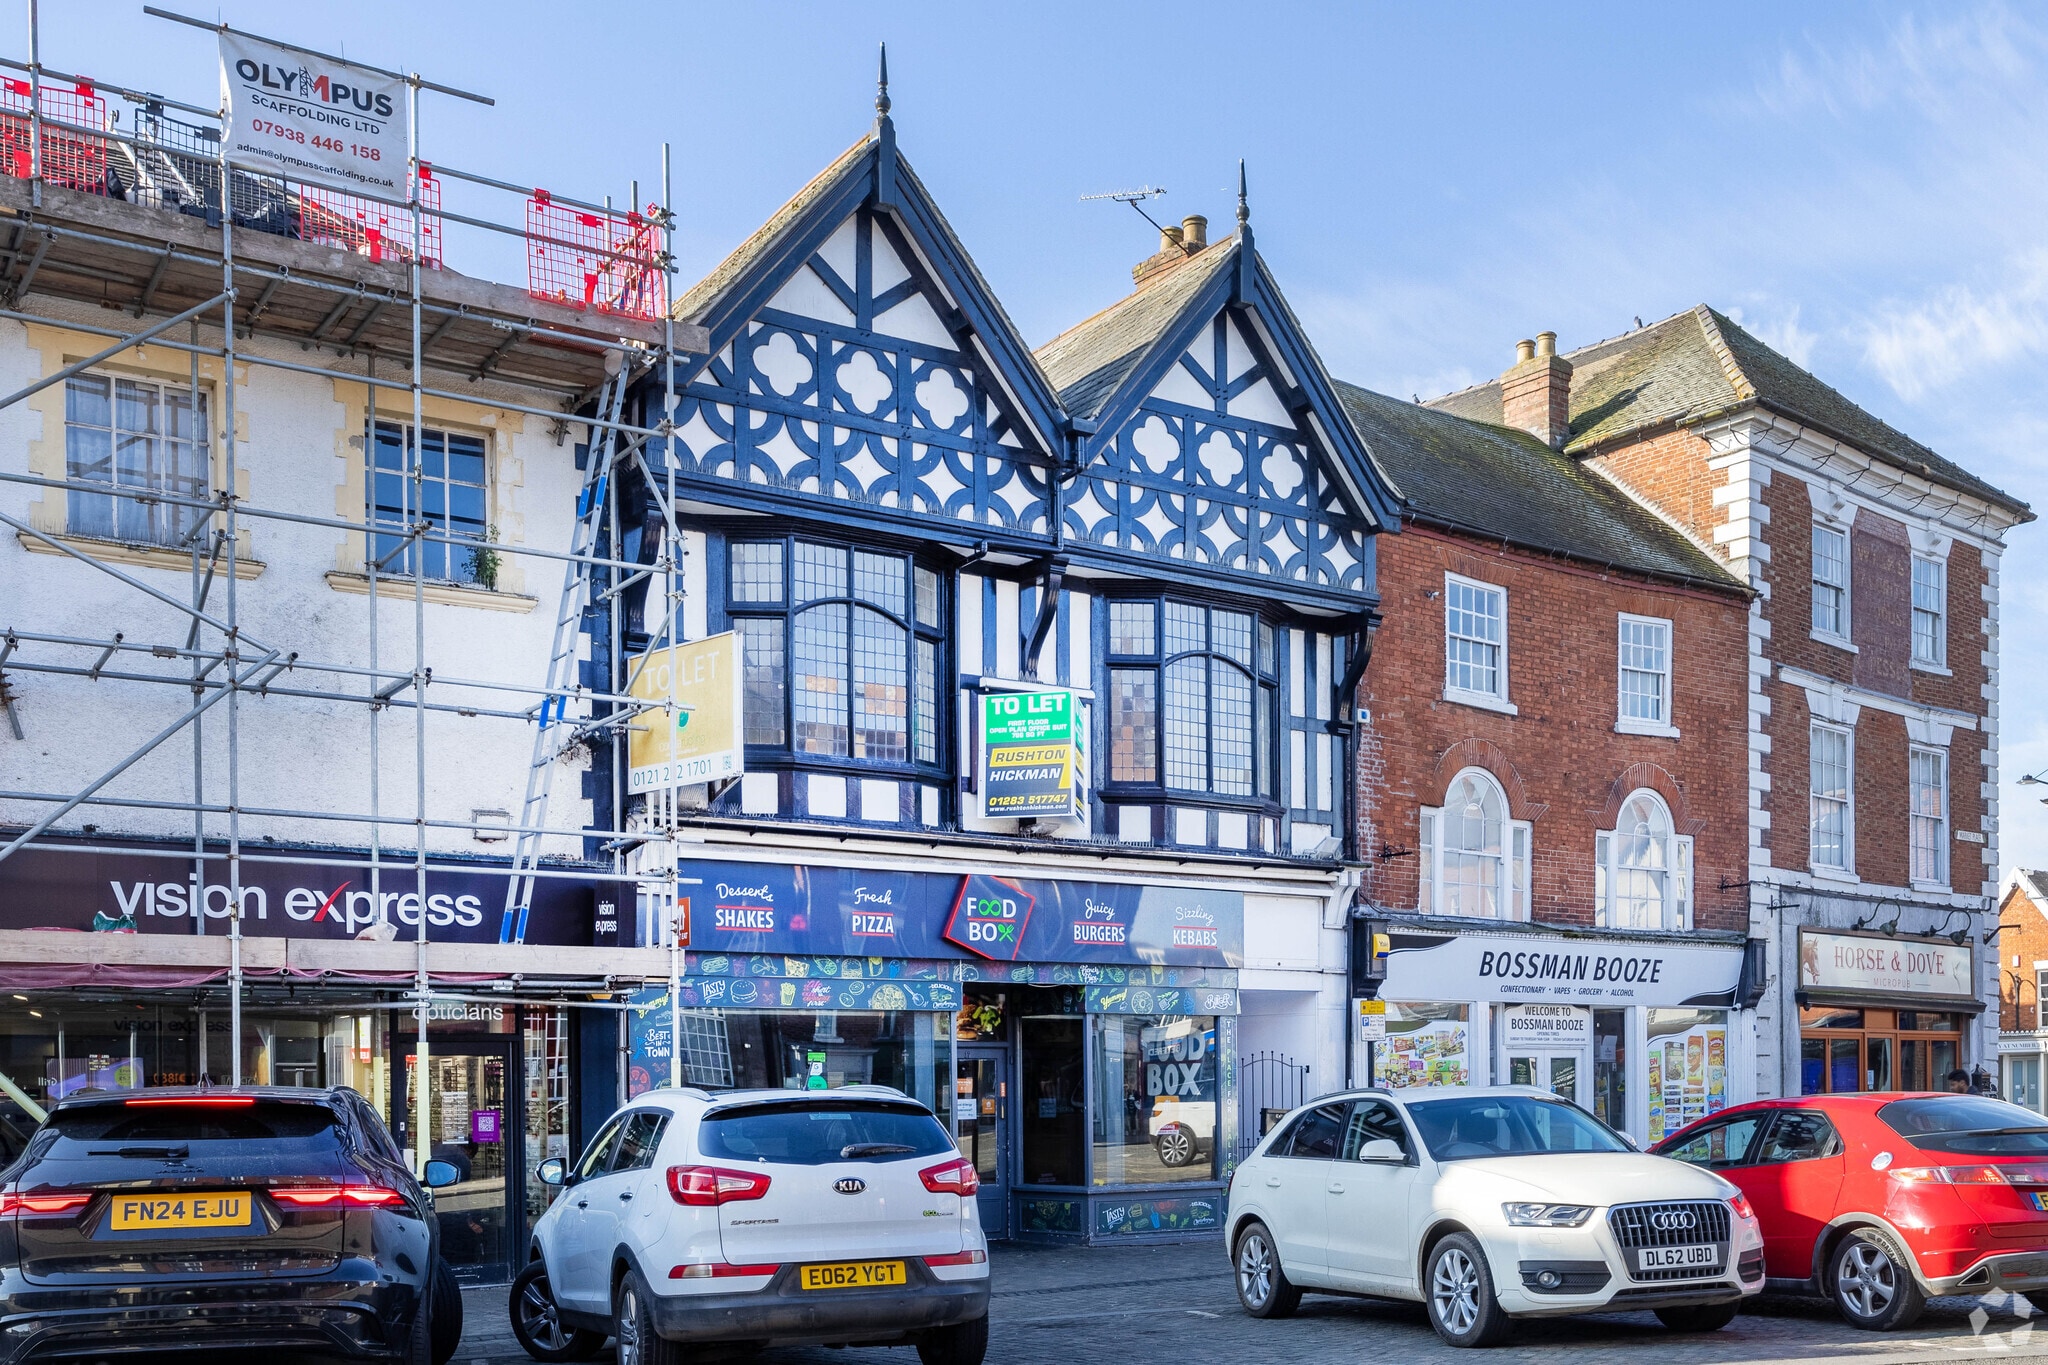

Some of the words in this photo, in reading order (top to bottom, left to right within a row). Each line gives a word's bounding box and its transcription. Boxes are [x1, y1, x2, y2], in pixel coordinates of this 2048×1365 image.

[235, 59, 393, 117] OLYMPUS
[251, 94, 351, 128] SCAFFOLDING
[354, 120, 380, 135] LTD
[252, 118, 306, 145] 07938
[310, 135, 344, 153] 446
[350, 143, 381, 162] 158
[236, 143, 394, 188] admin@olympusscaffolding.co.uk
[643, 664, 671, 694] TO
[681, 651, 720, 686] LET
[991, 697, 1020, 715] TO
[1027, 694, 1067, 713] LET
[995, 749, 1066, 763] RUSHTON
[633, 769, 659, 787] 0121
[663, 764, 683, 782] 22
[687, 759, 712, 777] 1701
[989, 768, 1061, 782] HICKMAN
[989, 796, 1025, 806] 01283
[1028, 794, 1068, 805] 517747
[716, 883, 774, 903] Desserts
[854, 887, 892, 906] Fresh
[110, 873, 268, 920] vision
[285, 880, 483, 933] express
[598, 901, 615, 915] vision
[1085, 898, 1115, 921] Juicy
[716, 909, 774, 929] SHAKES
[852, 915, 894, 934] PIZZA
[1175, 904, 1214, 927] Sizzling
[595, 920, 617, 934] express
[1074, 924, 1125, 943] BURGERS
[1173, 929, 1217, 946] KEBABS
[1479, 951, 1588, 980] BOSSMAN
[1593, 957, 1664, 984] BOOZE
[1834, 946, 1885, 970] HORSE
[1891, 951, 1901, 972] &
[1907, 951, 1945, 975] DOVE
[697, 980, 726, 998] TASTY
[1500, 985, 1546, 994] CONFECTIONARY
[1553, 987, 1571, 995] VAPES
[1578, 987, 1603, 996] GROCERY
[1610, 988, 1634, 997] ALCOHOL
[1873, 977, 1911, 989] MICROPUB
[412, 1003, 504, 1024] opticians
[1525, 1006, 1560, 1016] WELCOME
[1561, 1007, 1571, 1016] TO
[113, 1017, 163, 1031] vision
[168, 1018, 233, 1034] expess
[1511, 1018, 1554, 1030] BOSSMAN
[1556, 1019, 1584, 1031] BOOZE
[647, 1029, 667, 1041] BEST
[646, 1046, 670, 1058] TOWN
[1147, 1063, 1201, 1097] BOX
[838, 1180, 863, 1191] KIA
[123, 1201, 185, 1221] FN24
[193, 1199, 239, 1219] EJU
[1102, 1206, 1125, 1224] TASTY
[1646, 1249, 1683, 1266] DL62
[1687, 1247, 1712, 1263] UBD
[809, 1266, 857, 1286] EO62
[862, 1264, 897, 1283] YGT
